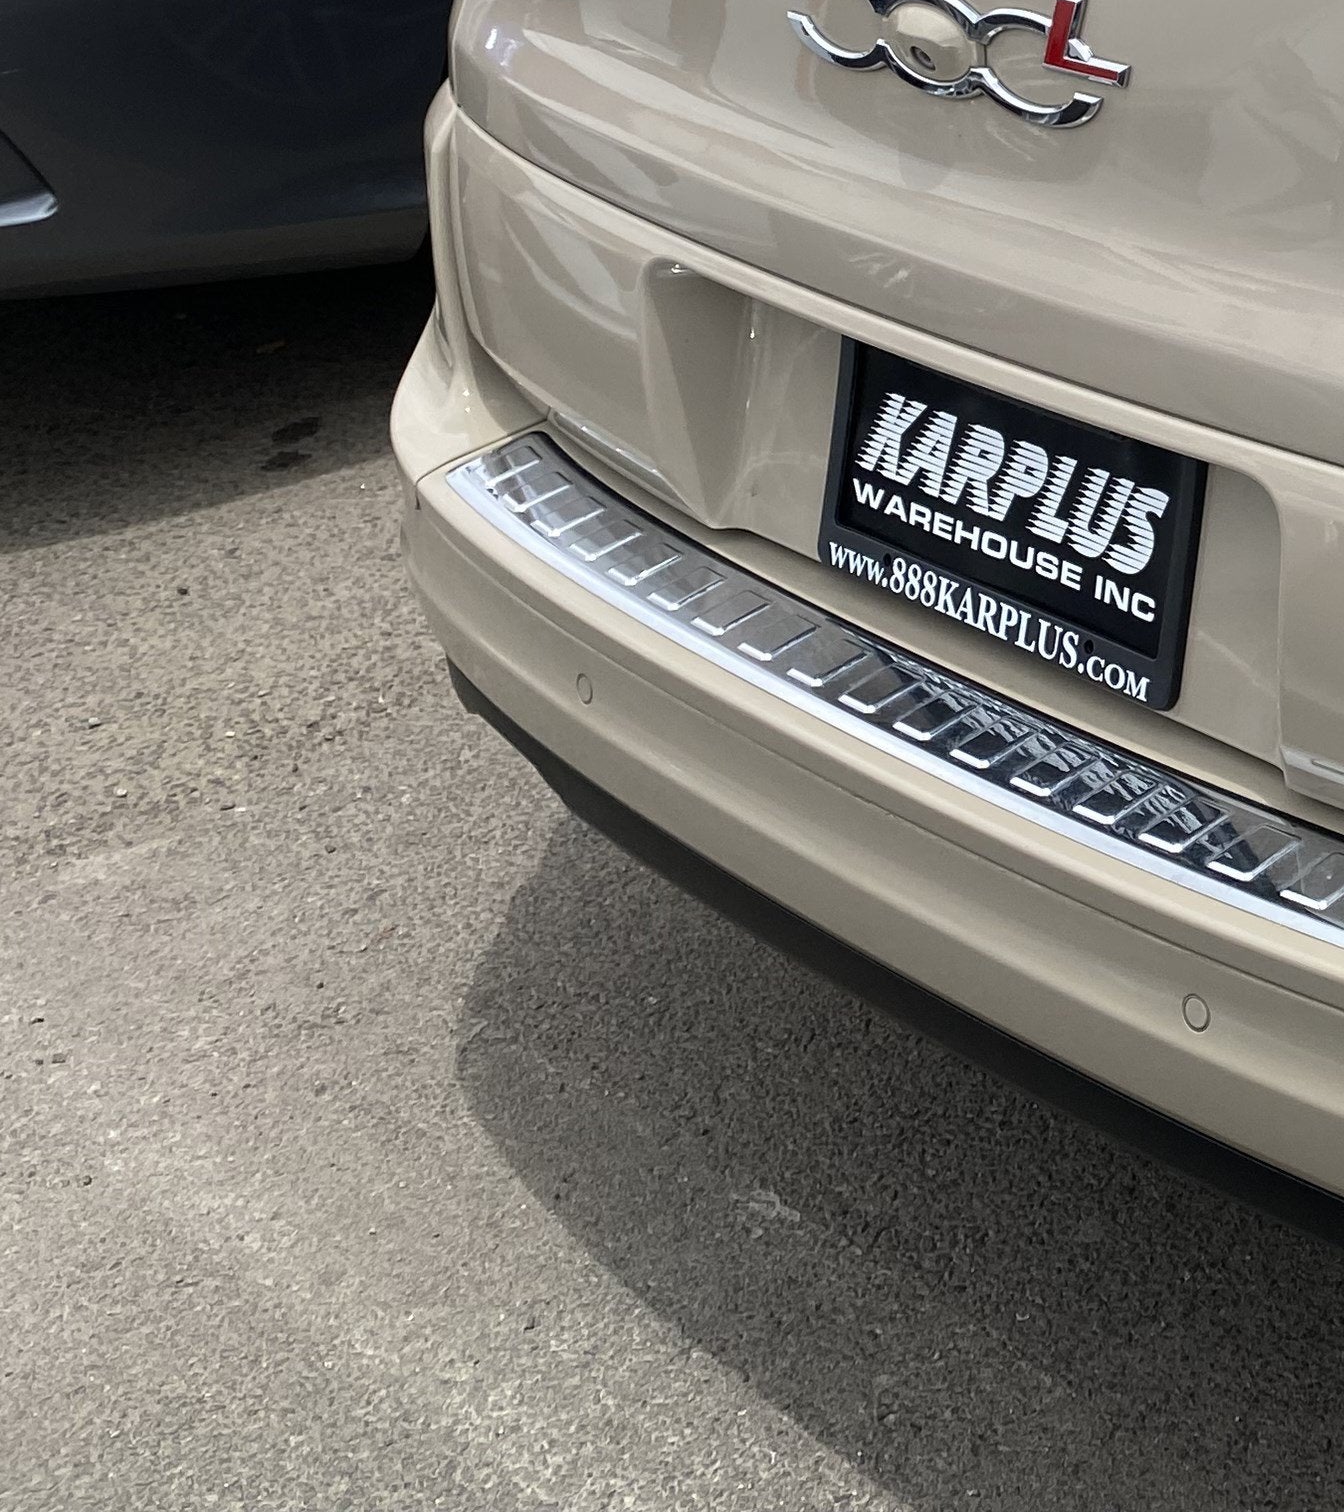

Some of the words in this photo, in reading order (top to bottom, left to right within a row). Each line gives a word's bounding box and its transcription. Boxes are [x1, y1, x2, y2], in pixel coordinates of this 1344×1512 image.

[852, 478, 1084, 591] WAREHOUSE
[1095, 575, 1157, 623] INC
[855, 392, 1170, 575] KARPLUS
